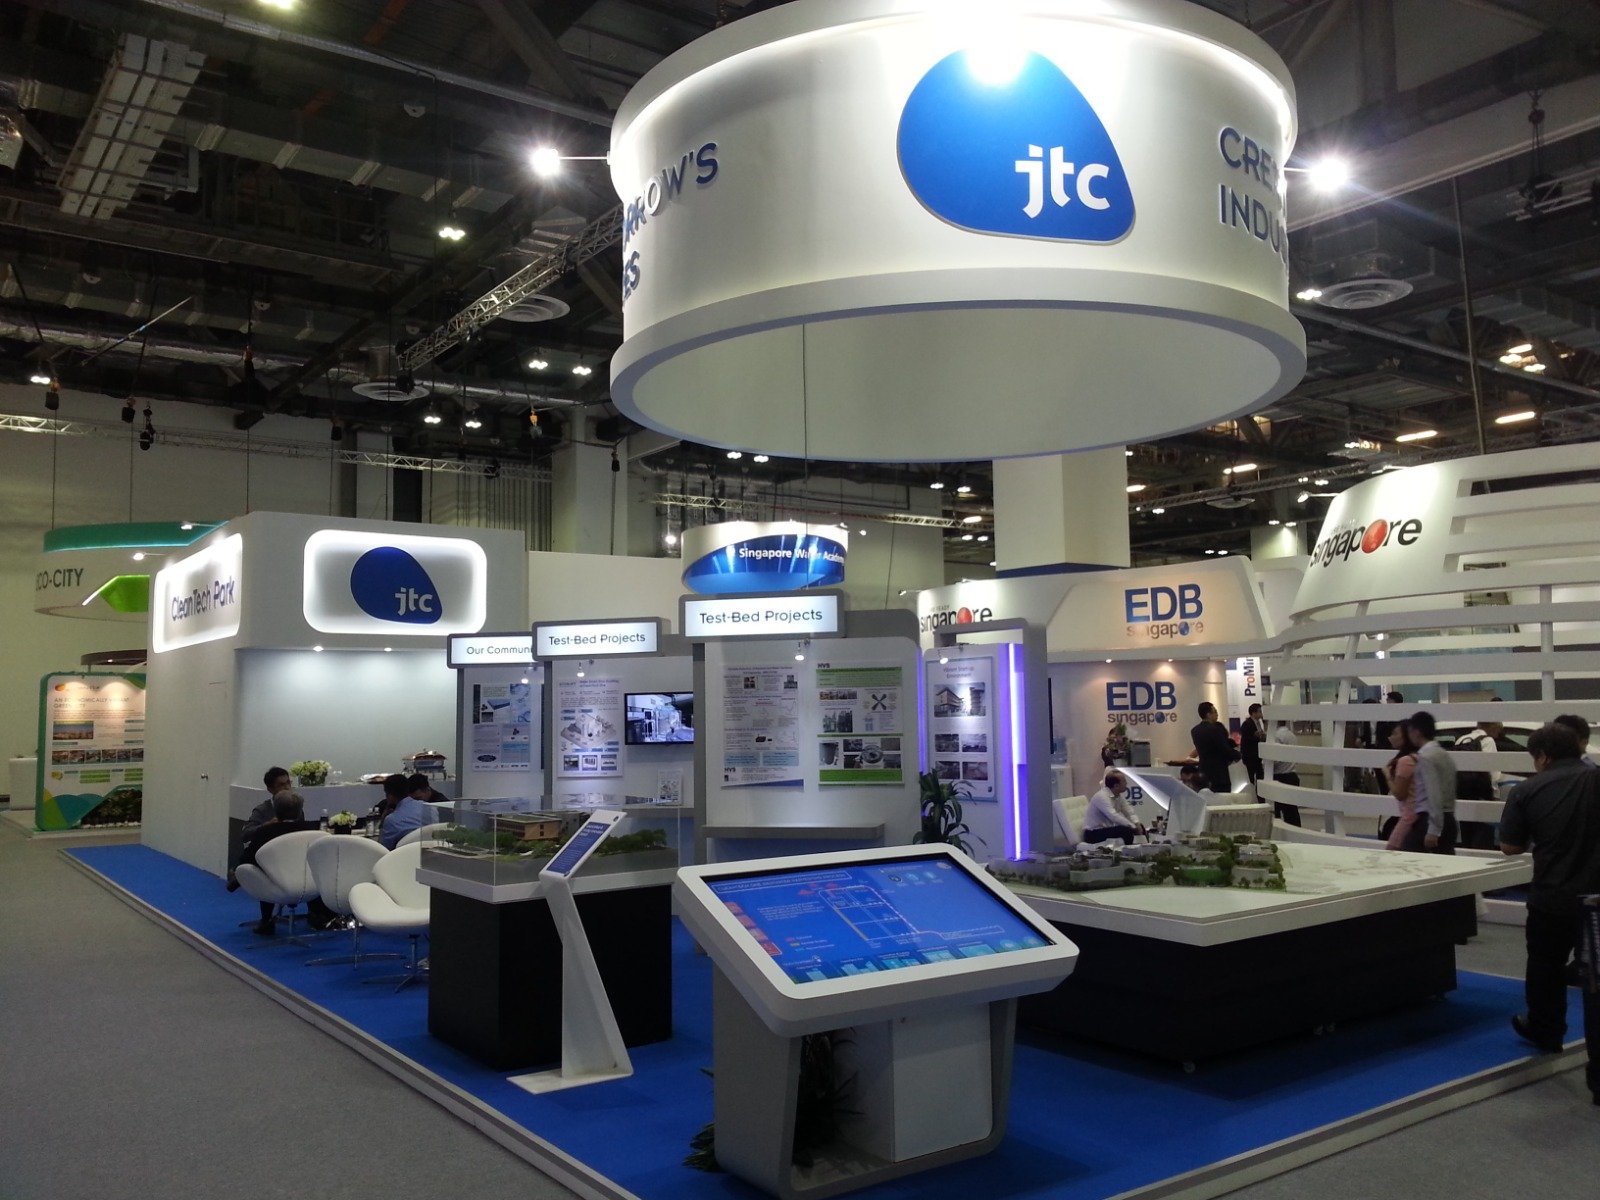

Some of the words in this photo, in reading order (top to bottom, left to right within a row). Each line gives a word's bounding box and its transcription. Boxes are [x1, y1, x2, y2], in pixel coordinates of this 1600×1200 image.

[1014, 144, 1110, 218] jtc
[739, 547, 793, 560] Singapore
[171, 586, 211, 622] CleanTech
[213, 575, 236, 609] Park
[394, 586, 433, 616] jtc
[1124, 583, 1203, 623] EDB
[699, 611, 760, 624] Test-Bed
[765, 609, 823, 623] Projects
[466, 646, 485, 655] Our
[549, 635, 597, 646] Test-Bed
[600, 632, 646, 645] Projects
[1106, 681, 1177, 711] EDB
[1107, 710, 1178, 726] singapore
